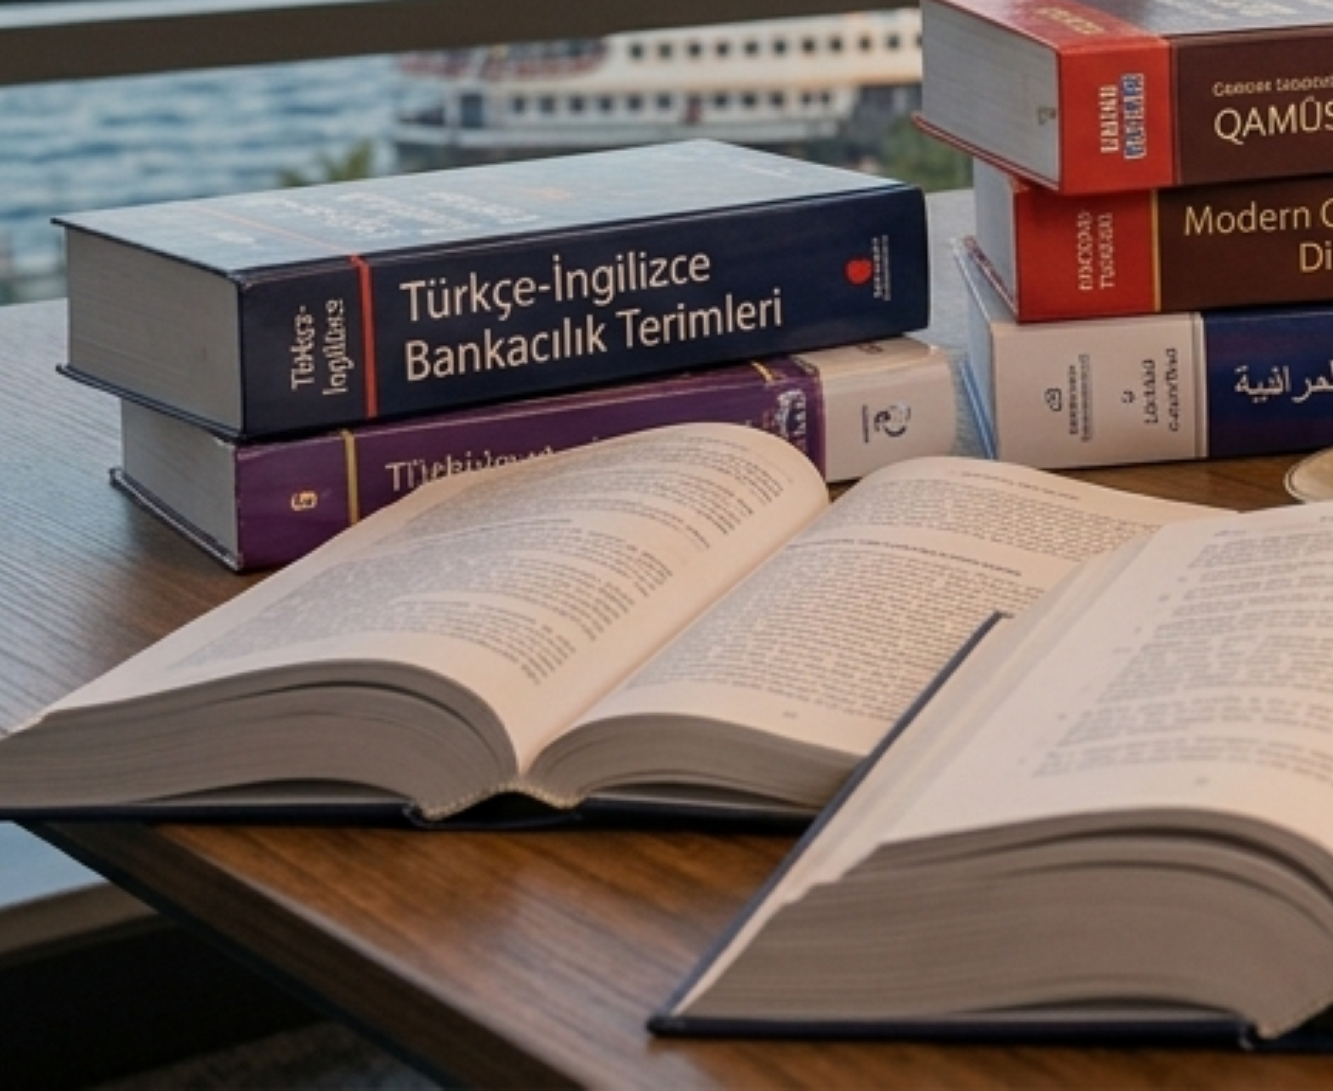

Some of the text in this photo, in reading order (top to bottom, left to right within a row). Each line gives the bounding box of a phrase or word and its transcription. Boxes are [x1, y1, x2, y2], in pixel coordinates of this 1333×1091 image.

[1184, 201, 1311, 236] Modern
[399, 252, 711, 321] Türkçe-İngilizce
[405, 287, 782, 382] Bankacılık Terimleri
